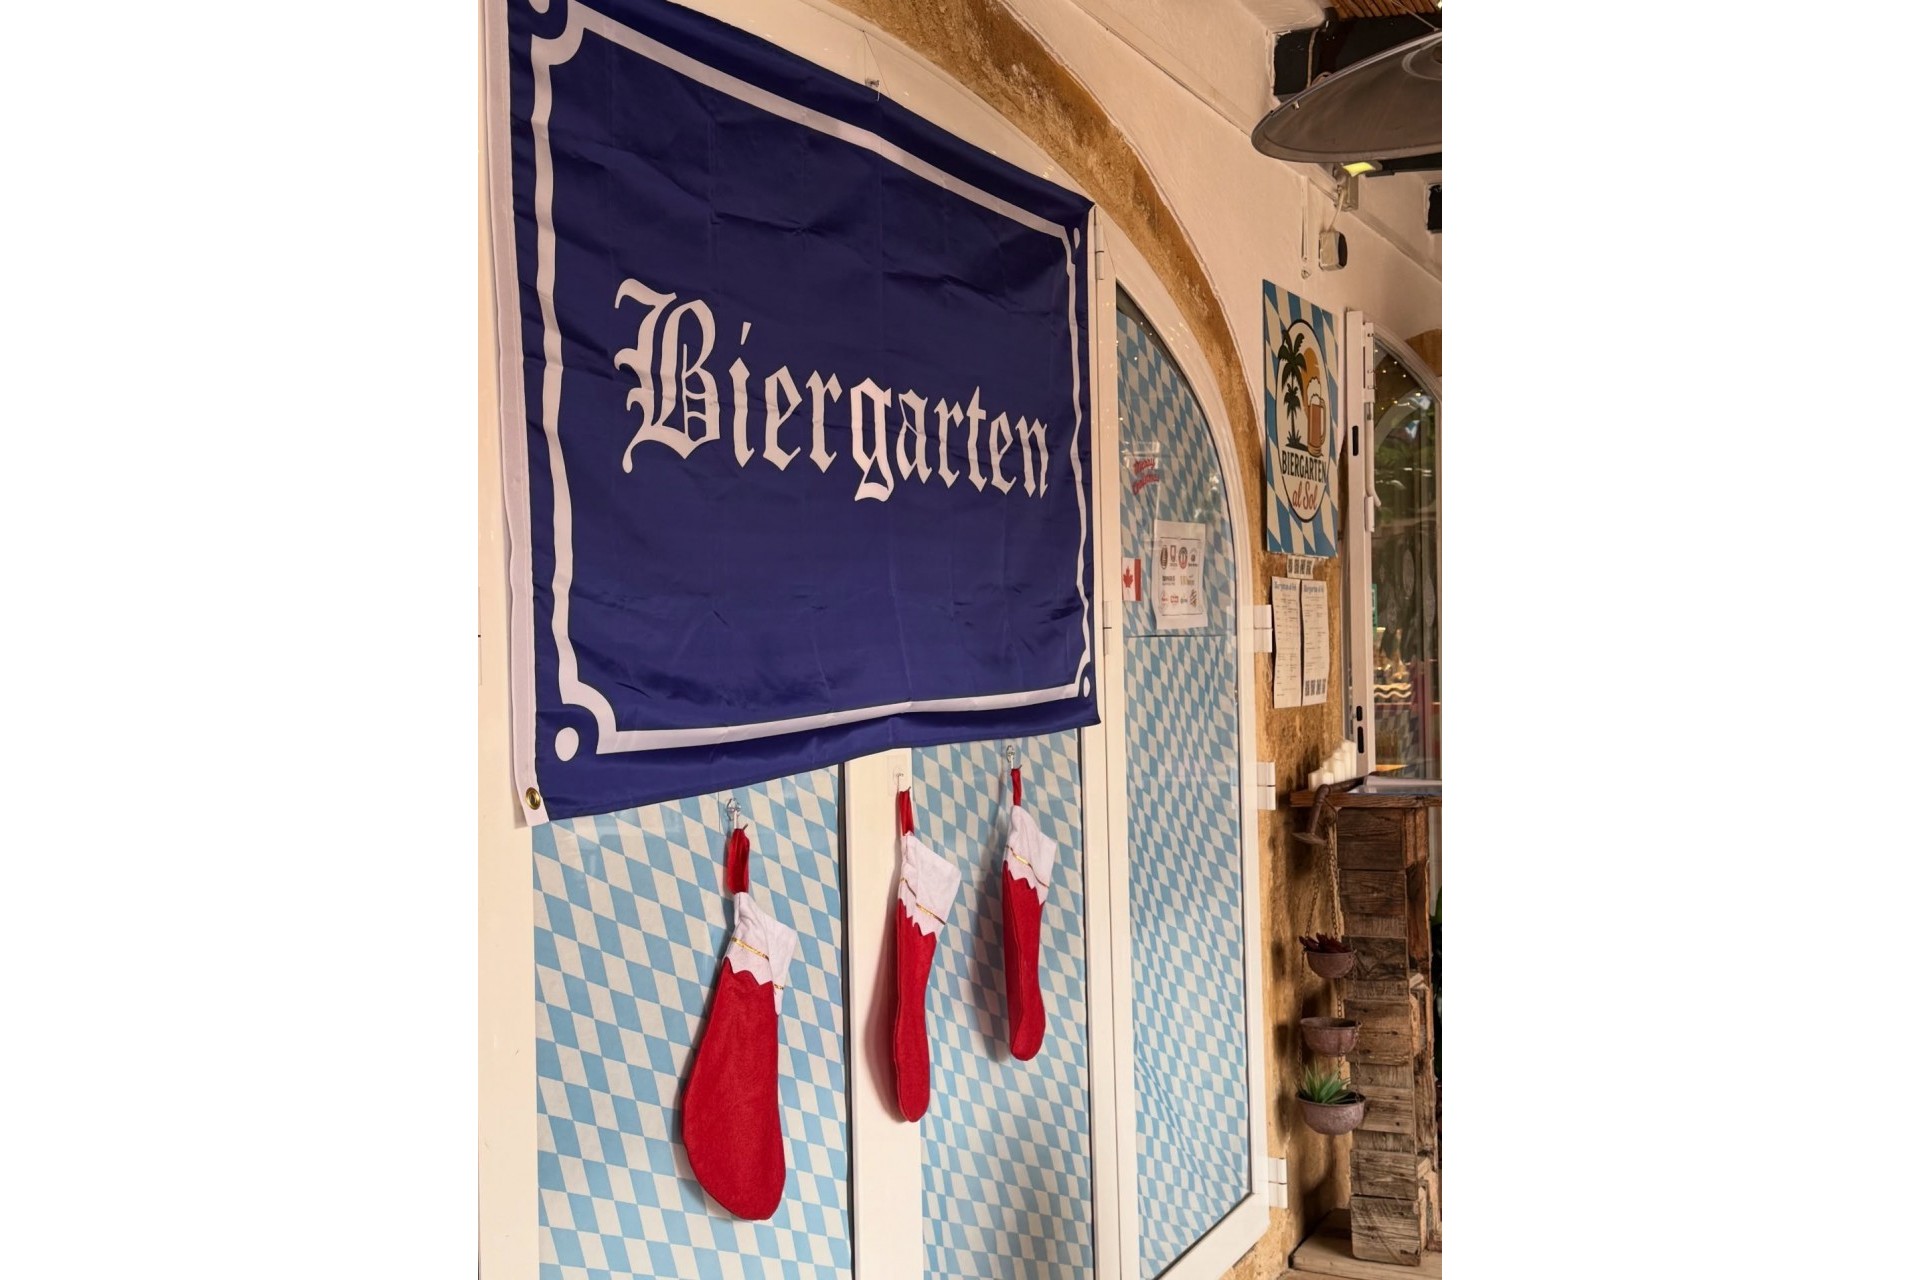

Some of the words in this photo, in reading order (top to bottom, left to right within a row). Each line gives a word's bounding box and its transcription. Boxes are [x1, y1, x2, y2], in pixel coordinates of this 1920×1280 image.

[614, 278, 1049, 502] Biergarten
[1281, 450, 1327, 483] BIERGARTEN
[1292, 481, 1303, 508] al
[1303, 481, 1318, 510] Sol
